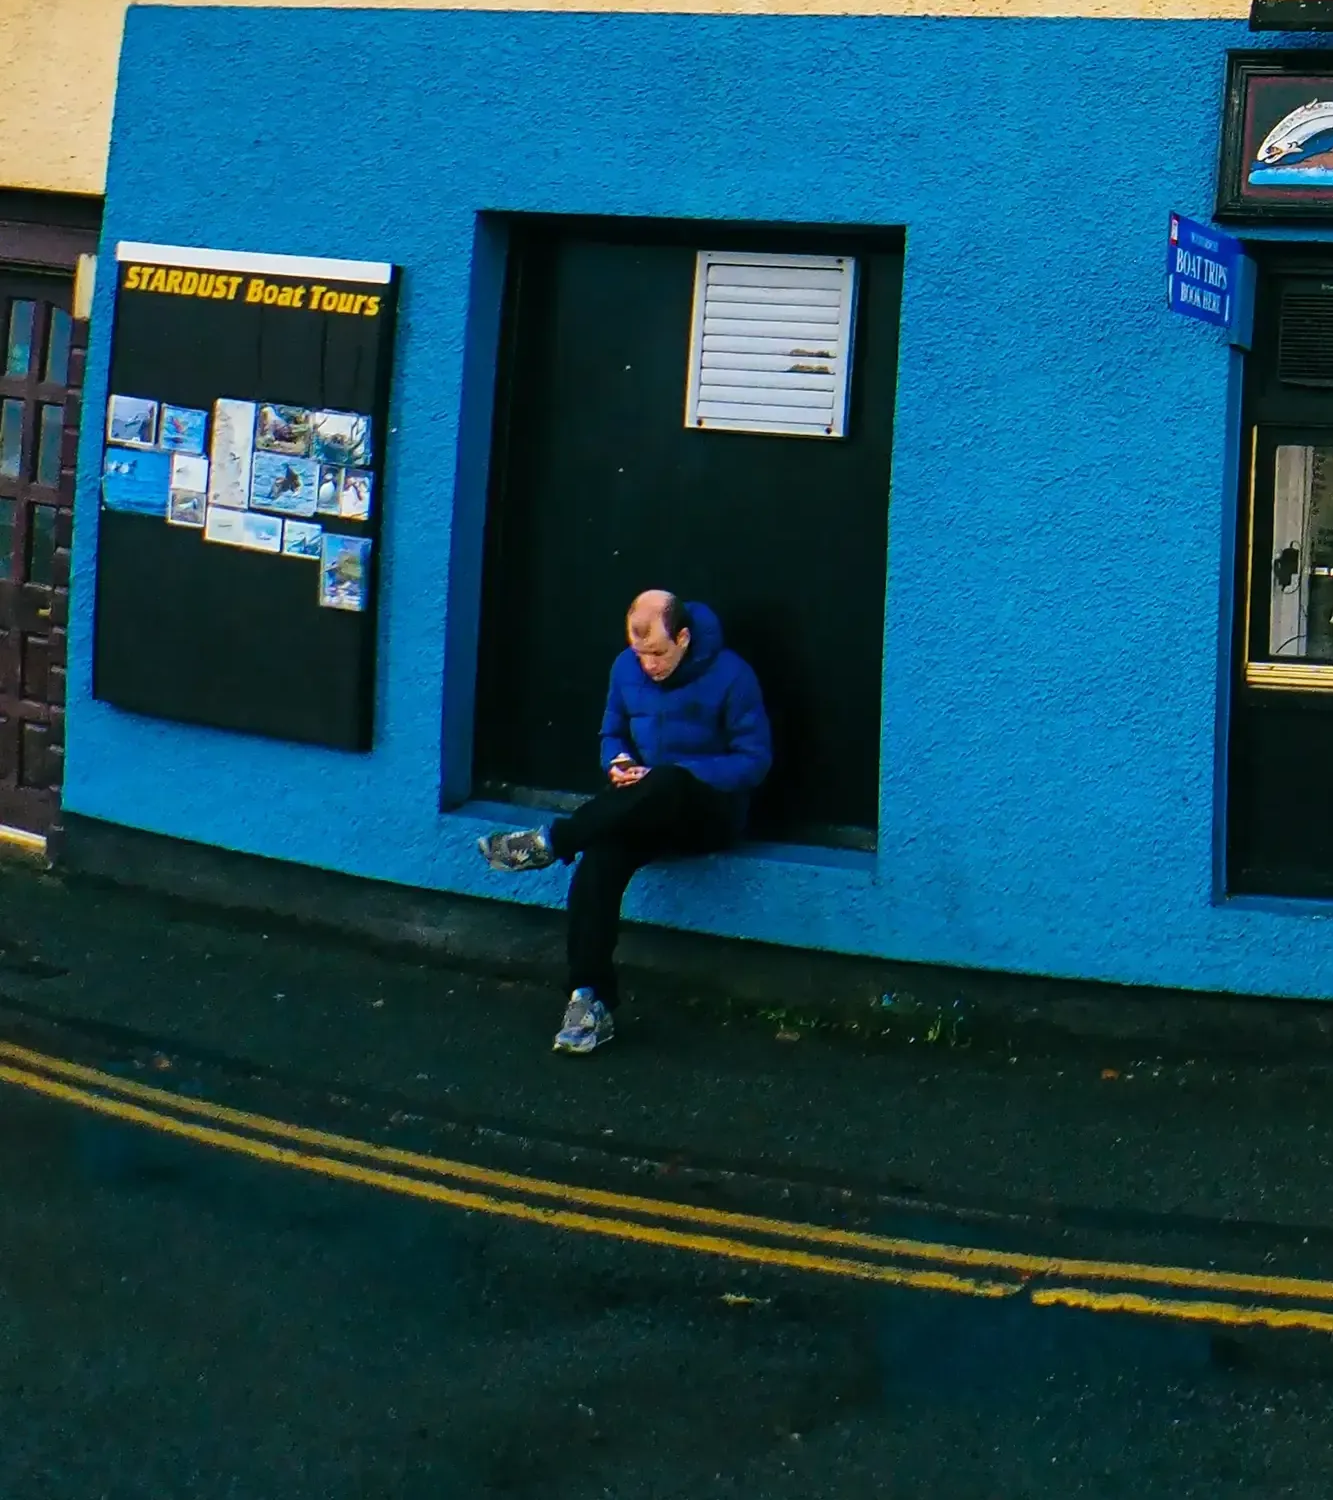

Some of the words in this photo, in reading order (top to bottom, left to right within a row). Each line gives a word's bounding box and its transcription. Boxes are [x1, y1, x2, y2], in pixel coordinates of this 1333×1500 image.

[124, 265, 243, 301] STARDUST
[245, 278, 304, 308] Boat
[308, 285, 381, 317] Tours
[1176, 247, 1202, 280] BOAT
[1203, 259, 1229, 290] TRIPS
